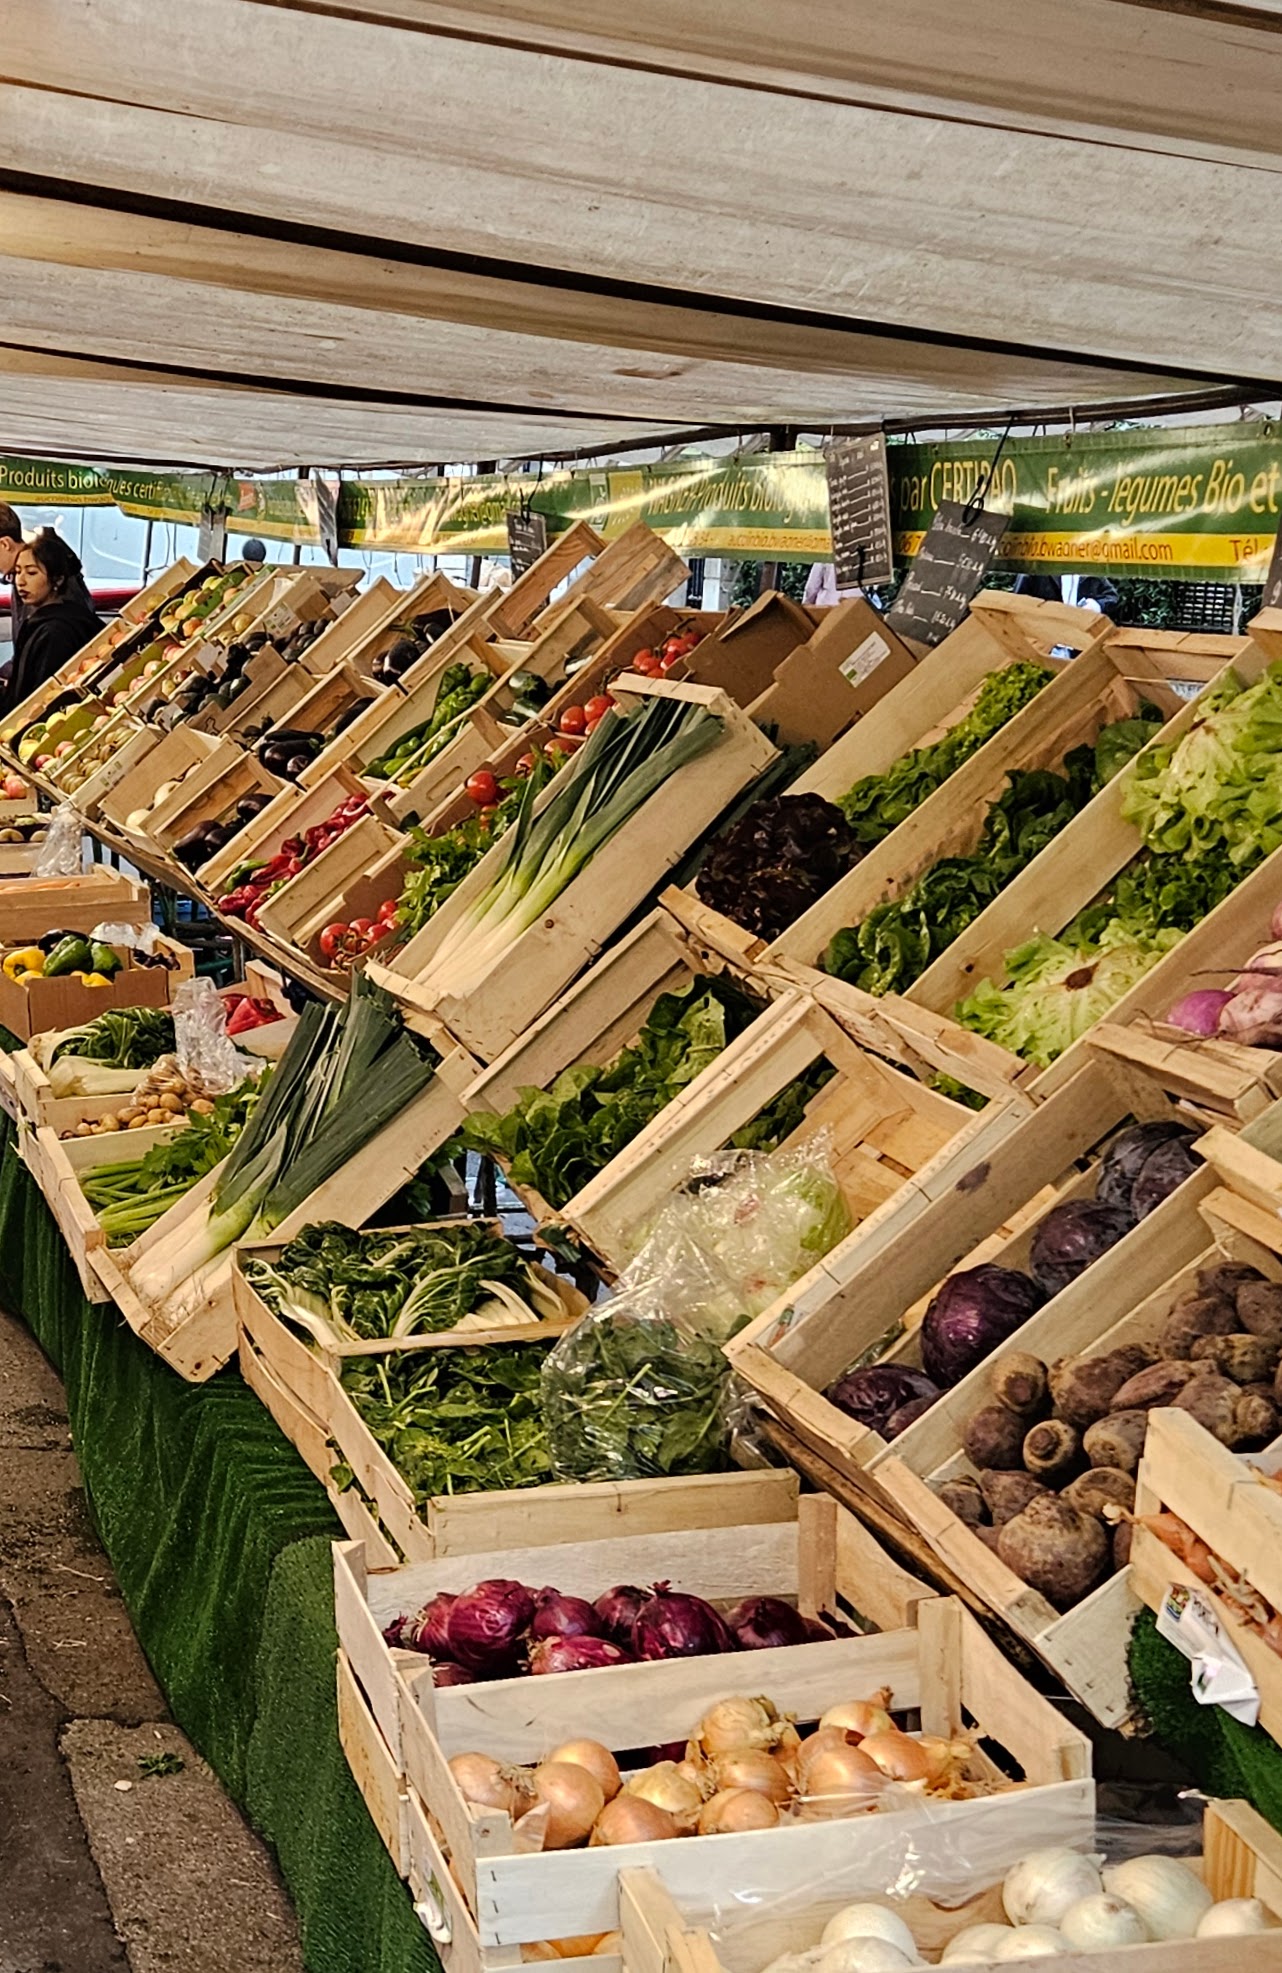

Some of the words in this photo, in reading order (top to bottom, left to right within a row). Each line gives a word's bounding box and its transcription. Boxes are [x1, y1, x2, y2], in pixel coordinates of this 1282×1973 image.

[0, 465, 64, 488] Produits
[1203, 459, 1245, 514] Bio
[1250, 461, 1280, 513] et
